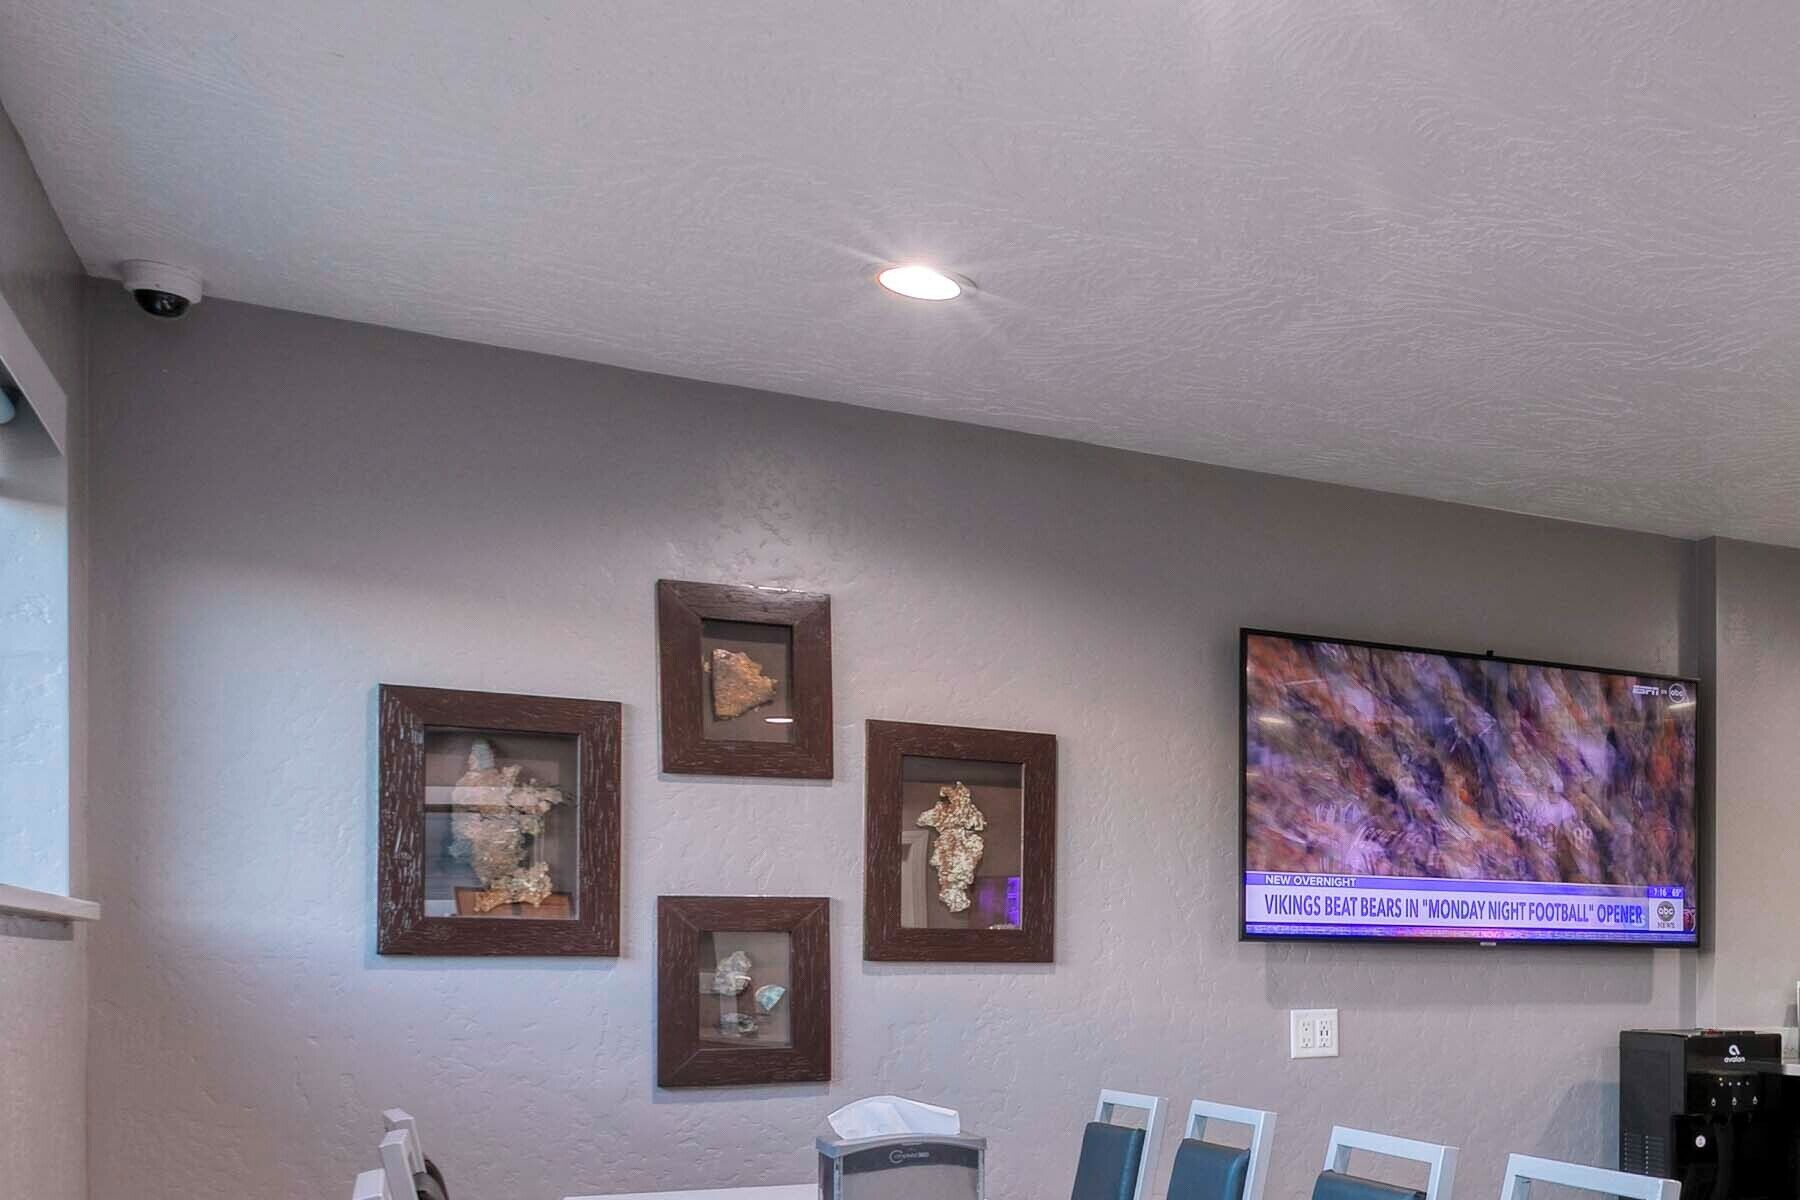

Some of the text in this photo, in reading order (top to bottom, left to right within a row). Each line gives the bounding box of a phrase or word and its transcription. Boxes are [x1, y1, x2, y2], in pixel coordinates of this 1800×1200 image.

[1265, 874, 1357, 888] NEW OVERNIGHT
[1265, 894, 1643, 924] VIKINGS BEAT BEARS IN "MONDAY NIGHT FOOTBALL" OPENER
